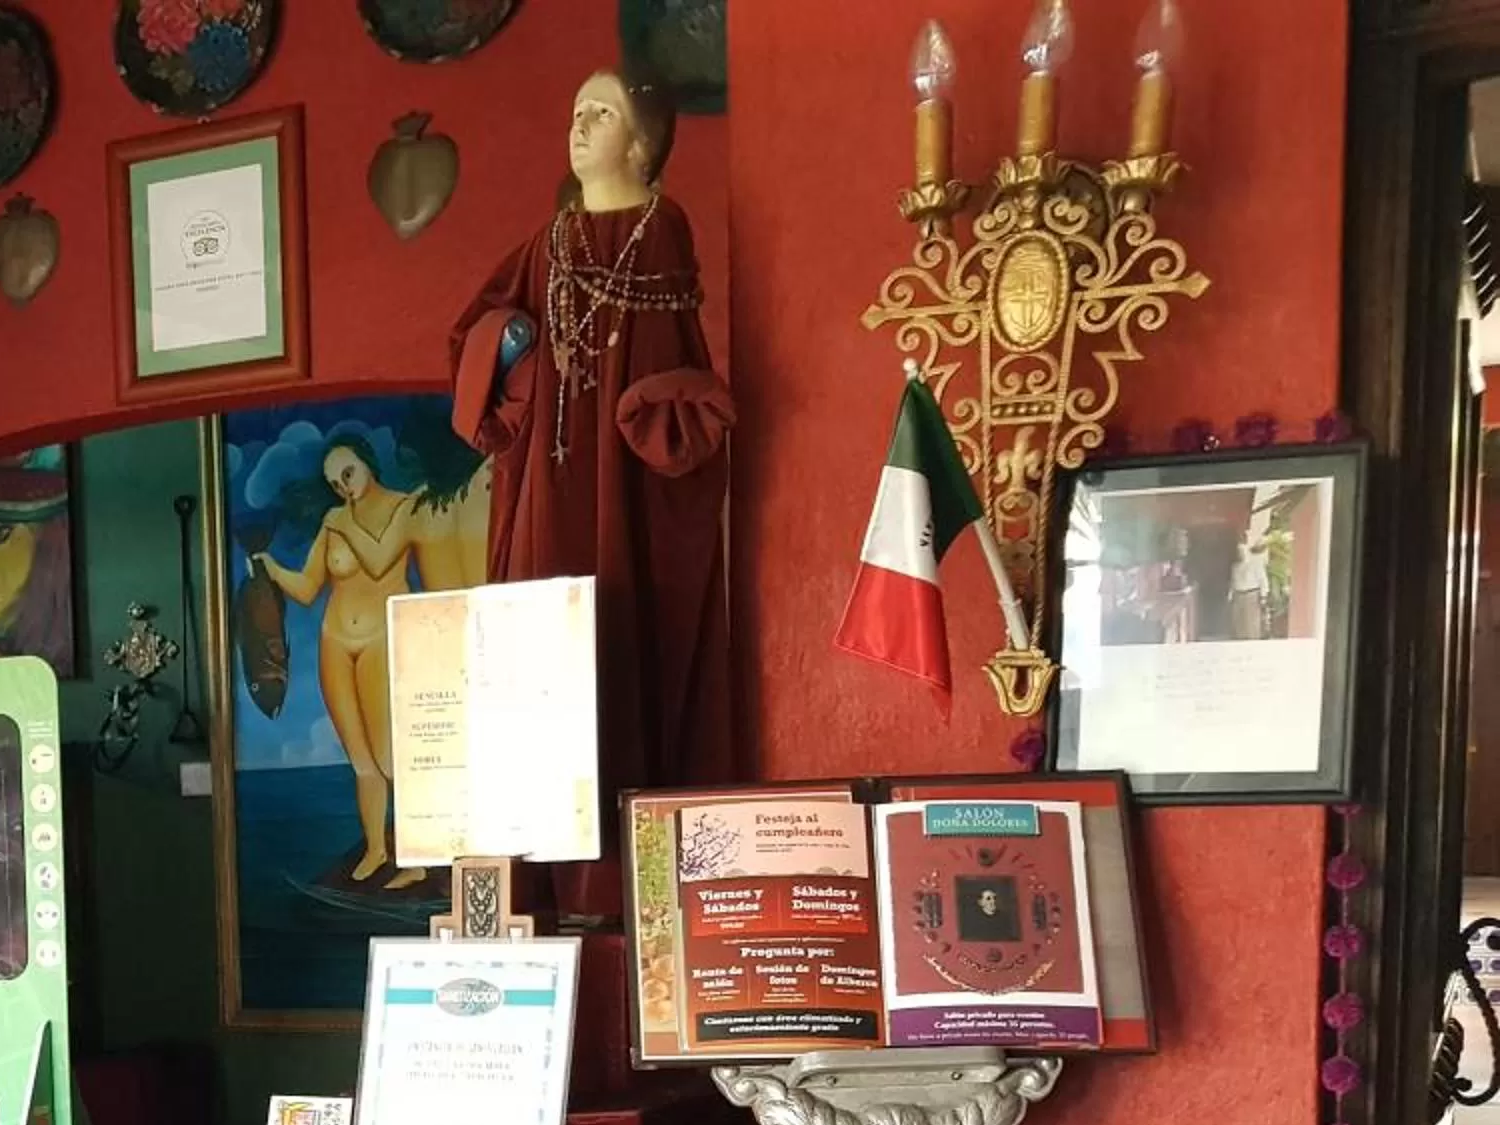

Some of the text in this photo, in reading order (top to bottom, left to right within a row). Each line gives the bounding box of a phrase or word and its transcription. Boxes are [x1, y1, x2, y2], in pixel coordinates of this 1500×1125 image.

[755, 812, 819, 826] Festeja al
[755, 826, 844, 839] cumpleañero
[697, 888, 764, 902] Viernes y
[791, 885, 859, 901] Sábados y
[702, 901, 760, 915] Sábados
[791, 899, 861, 913] Domingos
[740, 946, 805, 959] Pregunta
[795, 964, 810, 974] de
[768, 975, 798, 986] fotos
